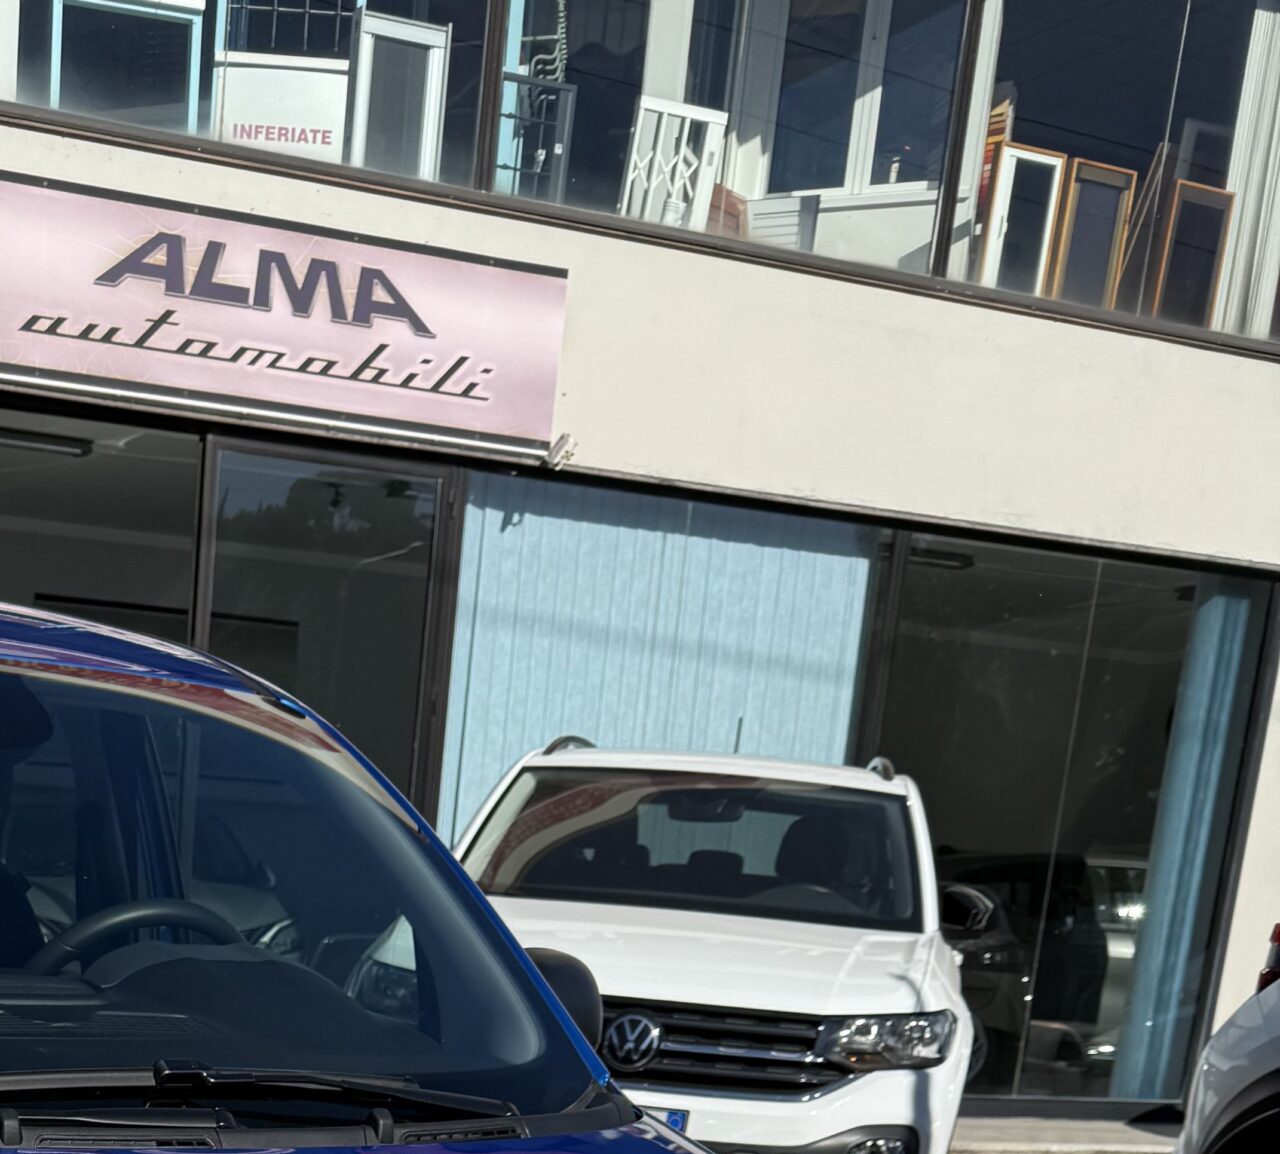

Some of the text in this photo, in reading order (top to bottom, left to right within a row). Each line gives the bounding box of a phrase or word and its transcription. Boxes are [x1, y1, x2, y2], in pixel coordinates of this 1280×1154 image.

[232, 123, 332, 145] INFERIATE
[93, 230, 436, 339] ALMA
[18, 309, 491, 401] automobili
